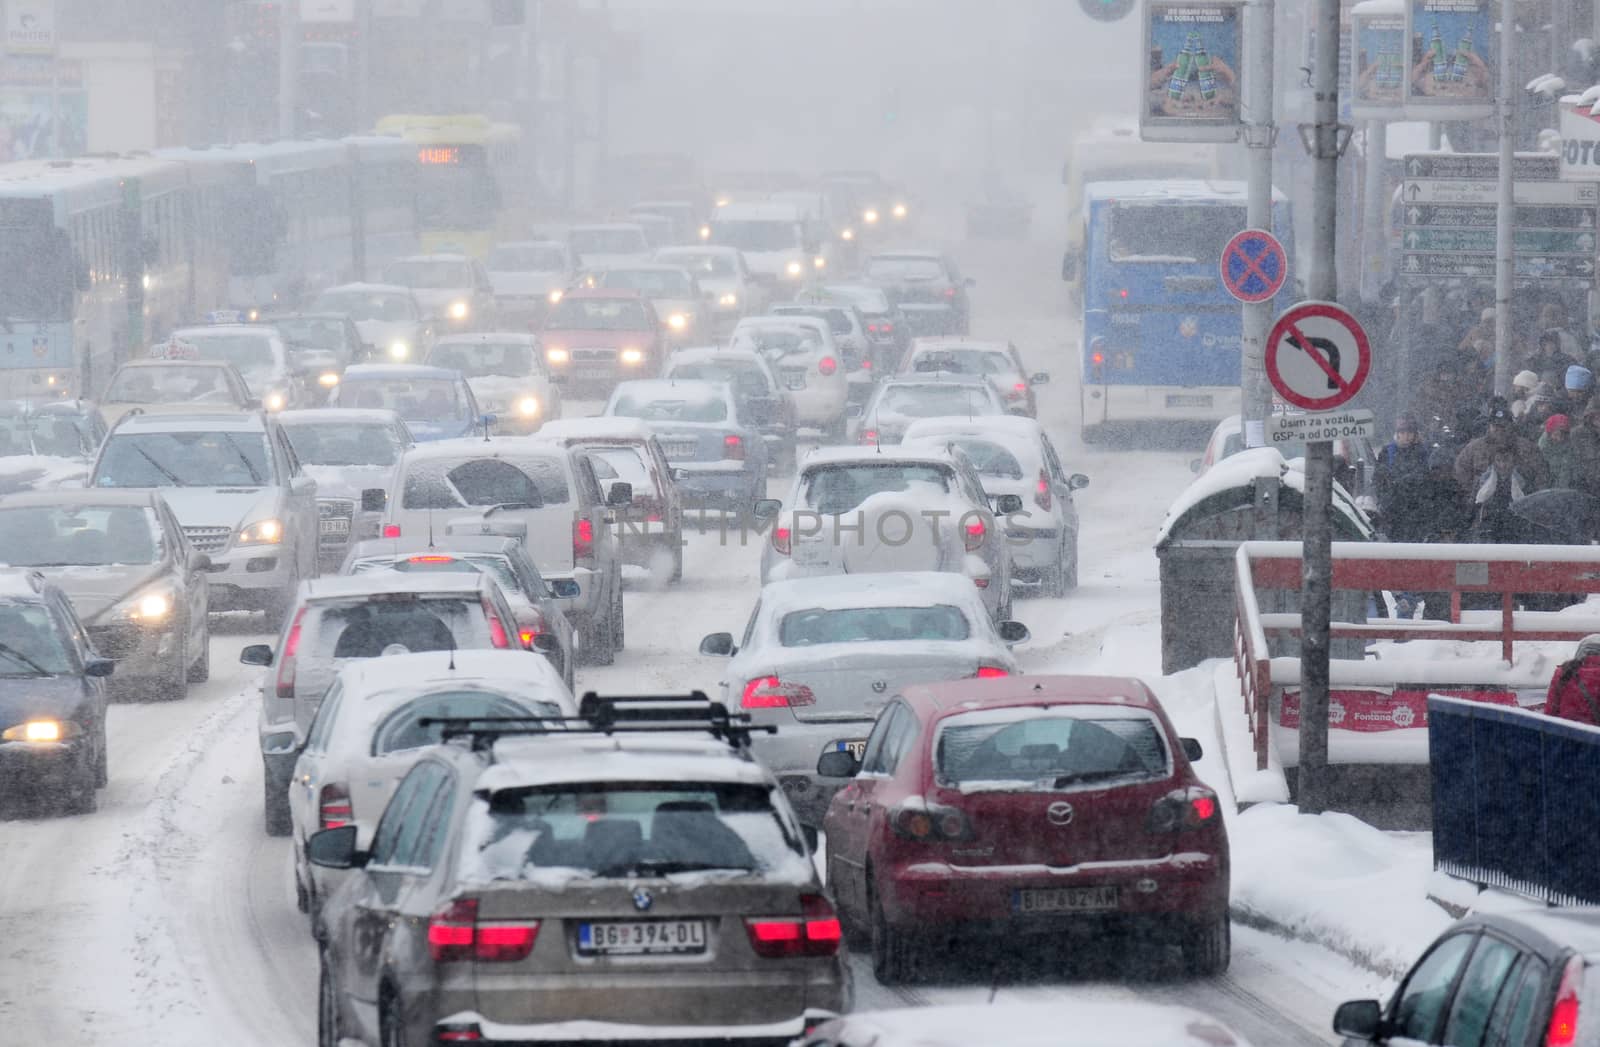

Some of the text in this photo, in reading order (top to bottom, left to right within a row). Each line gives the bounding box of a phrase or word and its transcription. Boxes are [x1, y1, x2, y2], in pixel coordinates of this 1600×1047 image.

[1280, 415, 1356, 429] Osim za vozila
[1273, 430, 1306, 442] GSP-a
[1308, 429, 1321, 440] od
[1354, 712, 1392, 721] Fontana
